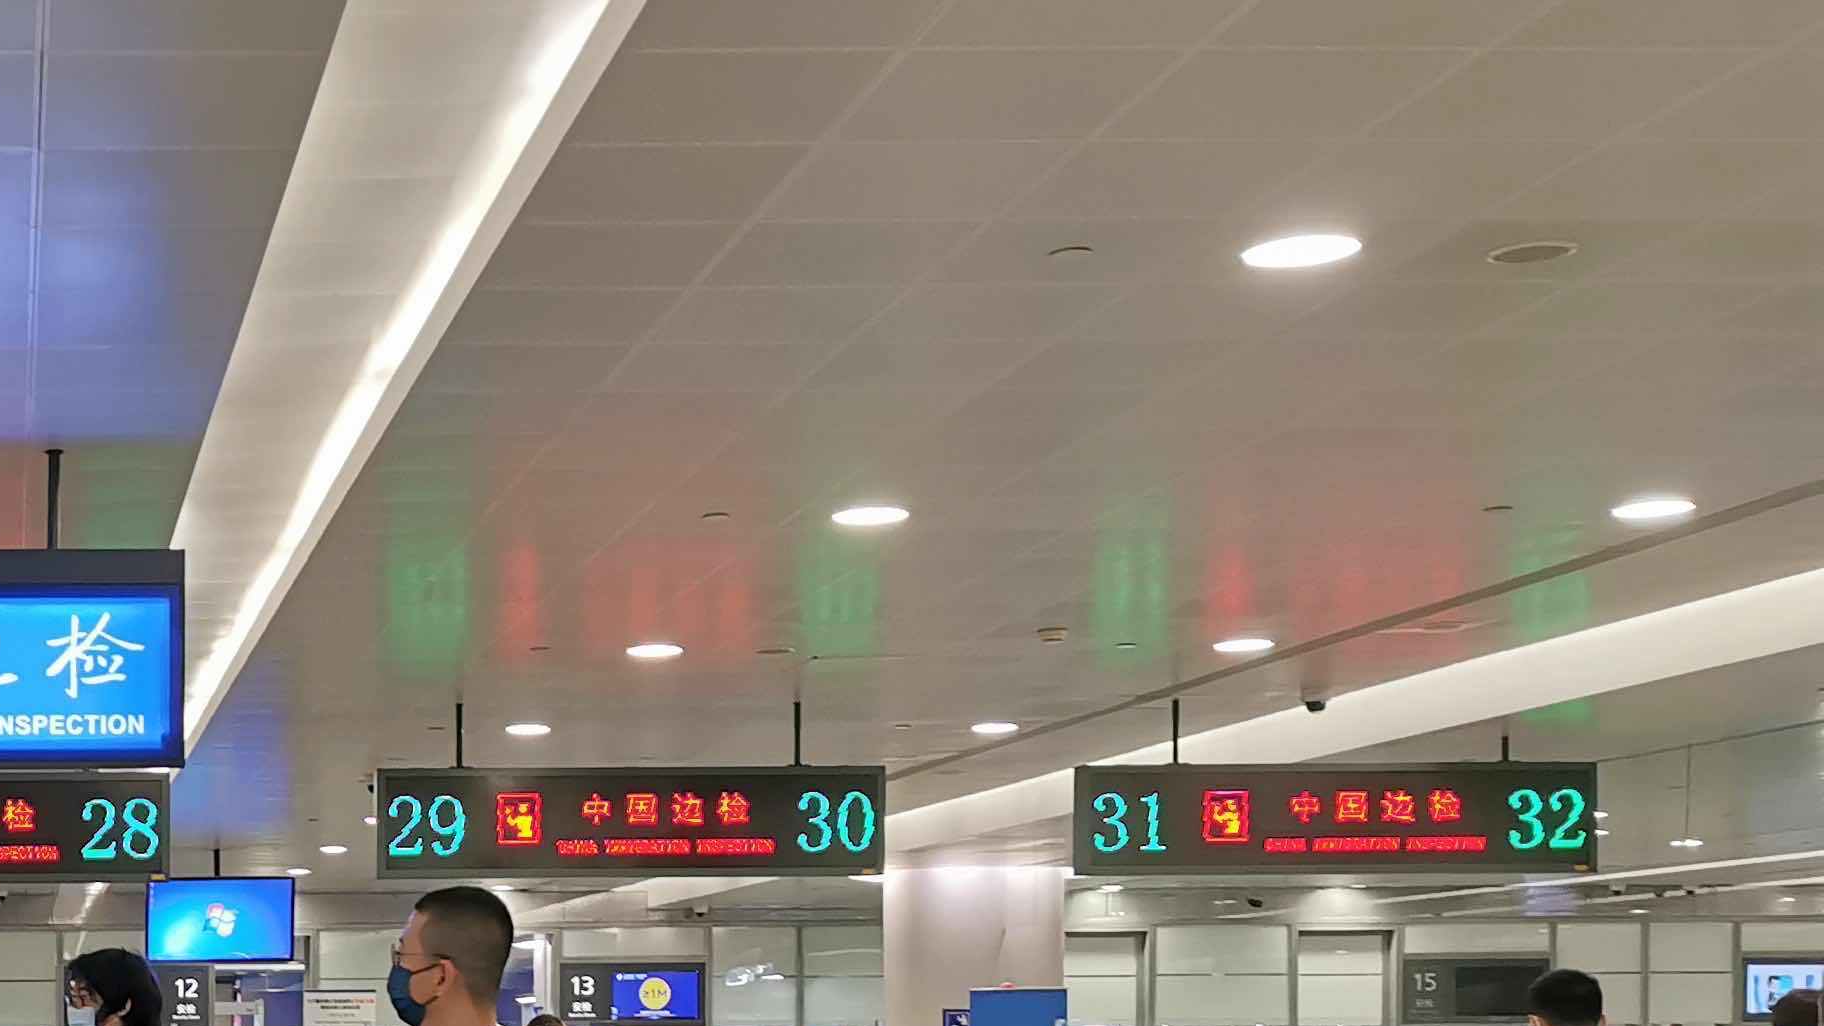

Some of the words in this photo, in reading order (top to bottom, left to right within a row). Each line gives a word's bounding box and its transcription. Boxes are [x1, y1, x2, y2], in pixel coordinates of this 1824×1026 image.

[81, 799, 160, 861] 28
[387, 795, 466, 857] 29
[581, 791, 752, 824] 中国边检
[796, 791, 876, 853] 30
[1092, 791, 1167, 853] 31
[1289, 789, 1463, 823] 中国边检
[1507, 788, 1587, 850] 32
[175, 979, 199, 998] 12
[570, 975, 595, 996] 13
[1413, 972, 1437, 991] 15
